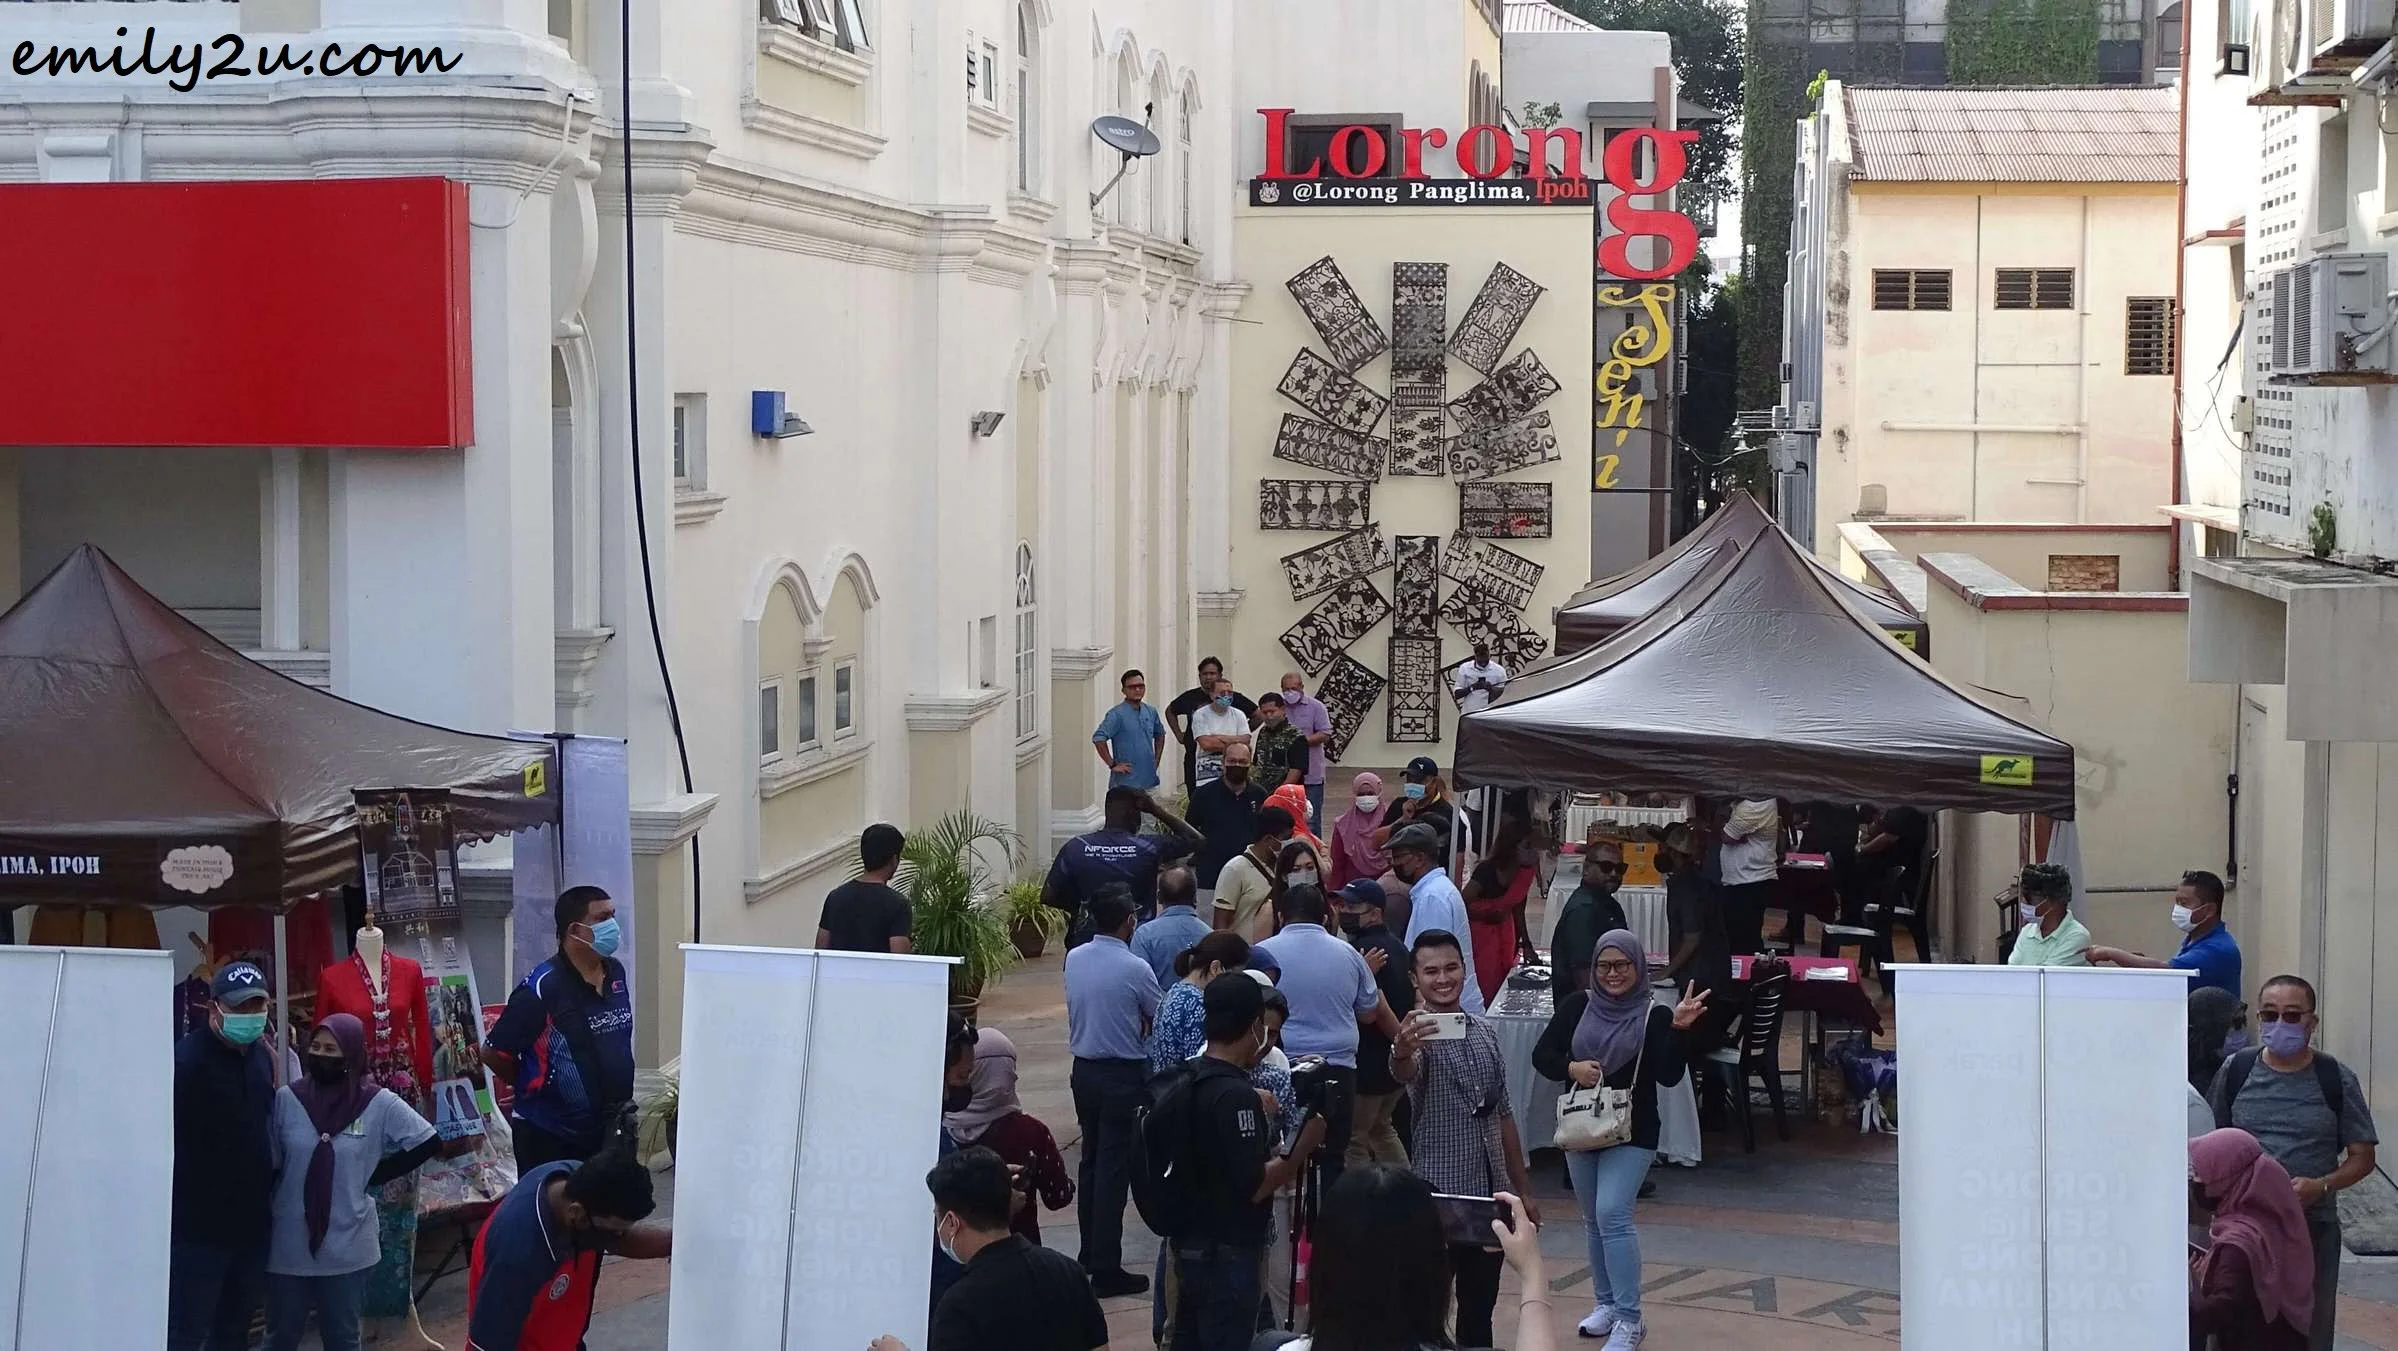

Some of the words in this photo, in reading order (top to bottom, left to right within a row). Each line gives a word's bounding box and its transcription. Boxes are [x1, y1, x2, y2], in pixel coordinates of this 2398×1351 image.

[1108, 127, 1135, 137] astro
[1256, 108, 1701, 280] Lorong
[1292, 181, 1398, 203] @Lorong
[1409, 181, 1531, 203] Panglima,
[1535, 177, 1589, 206] Ipoh
[1084, 845, 1137, 853] NFORCE
[0, 856, 44, 876] IMA,
[51, 856, 100, 875] IPOH
